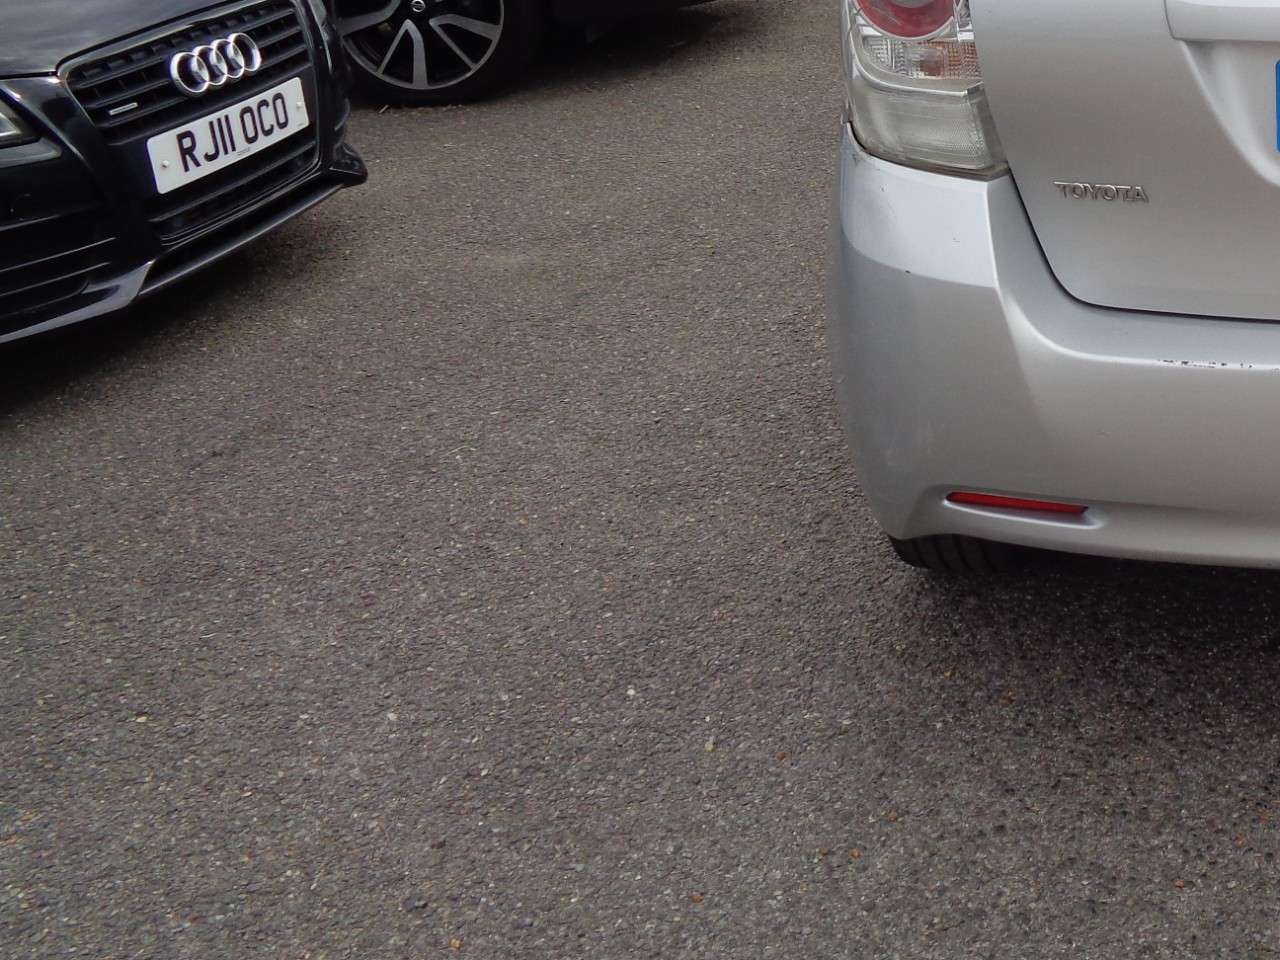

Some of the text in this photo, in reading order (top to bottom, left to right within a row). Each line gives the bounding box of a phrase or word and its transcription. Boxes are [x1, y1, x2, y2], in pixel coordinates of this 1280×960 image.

[176, 92, 289, 173] RJ11 OCO
[1053, 181, 1149, 204] TOYOTA
